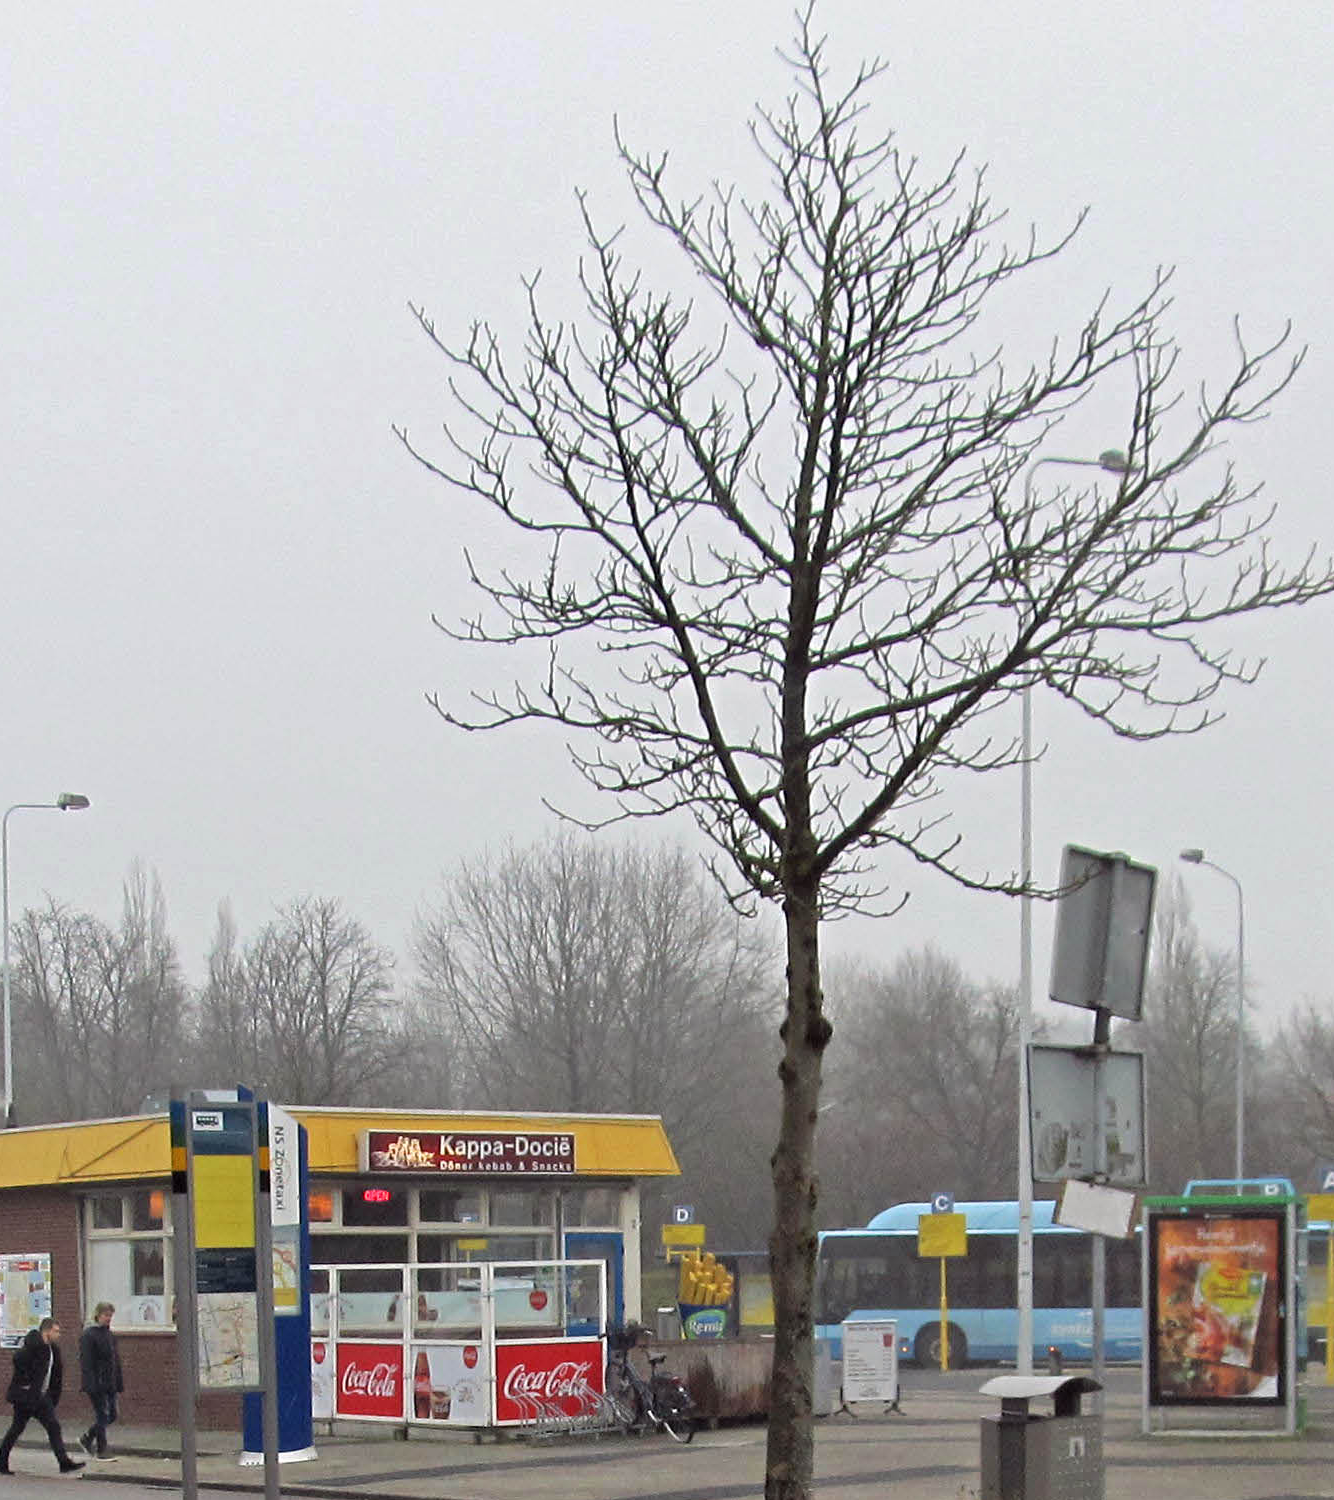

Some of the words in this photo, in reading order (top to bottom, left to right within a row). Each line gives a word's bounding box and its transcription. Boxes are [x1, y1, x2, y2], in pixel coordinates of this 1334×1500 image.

[274, 1126, 285, 1145] NS
[440, 1135, 571, 1160] Kappa-Docië
[365, 1191, 390, 1202] OPEN
[677, 1209, 688, 1222] D
